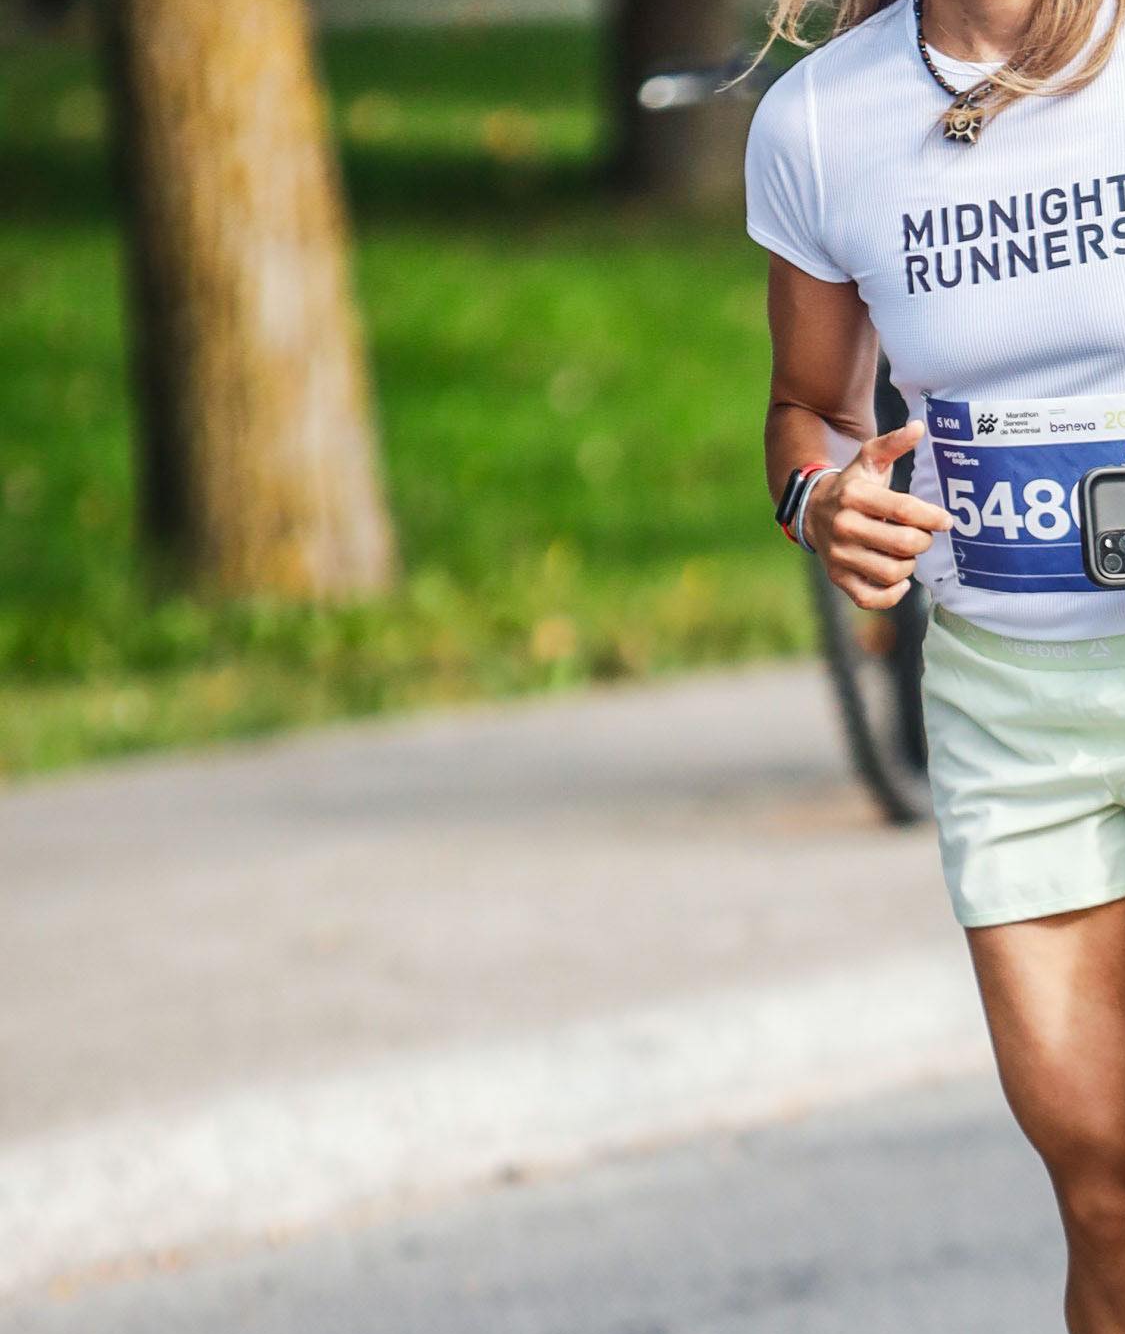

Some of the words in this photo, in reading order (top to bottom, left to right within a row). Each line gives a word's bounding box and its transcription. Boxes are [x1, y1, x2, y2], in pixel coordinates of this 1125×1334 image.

[1005, 411, 1039, 419] Marathon
[936, 416, 944, 428] 5
[943, 418, 960, 430] KM
[1049, 421, 1096, 433] beneva
[943, 450, 965, 459] sports
[946, 477, 1080, 541] 548
[1001, 636, 1079, 660] Reebok
